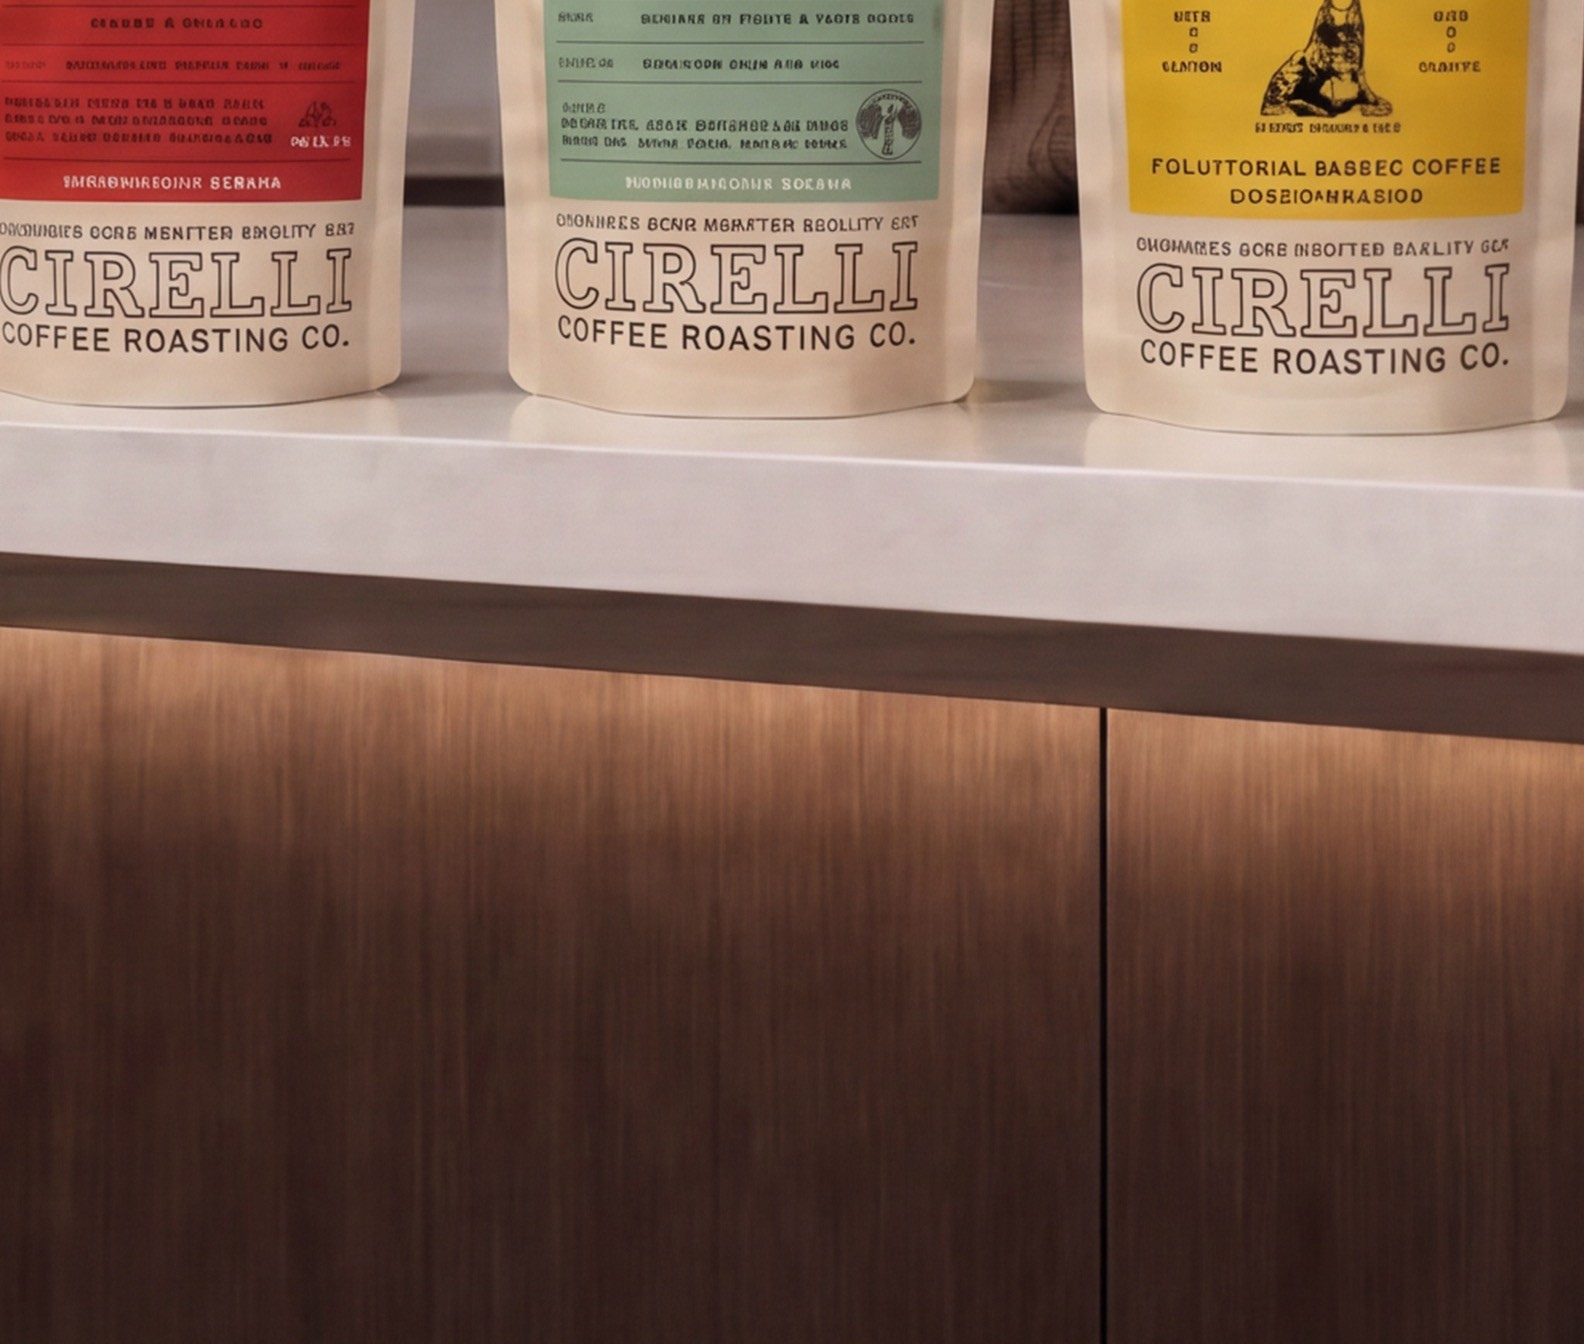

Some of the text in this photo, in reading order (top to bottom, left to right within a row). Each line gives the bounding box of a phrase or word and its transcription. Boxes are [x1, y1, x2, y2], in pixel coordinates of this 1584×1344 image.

[1412, 156, 1501, 176] COFFEE
[554, 237, 918, 317] CIRELLI
[1136, 262, 1510, 341] CIRELLI
[2, 321, 349, 354] COFFEE ROASTING CO.
[557, 311, 916, 352] COFFEE ROASTING CO.
[1140, 338, 1509, 375] COFFEE ROASTING CO.
